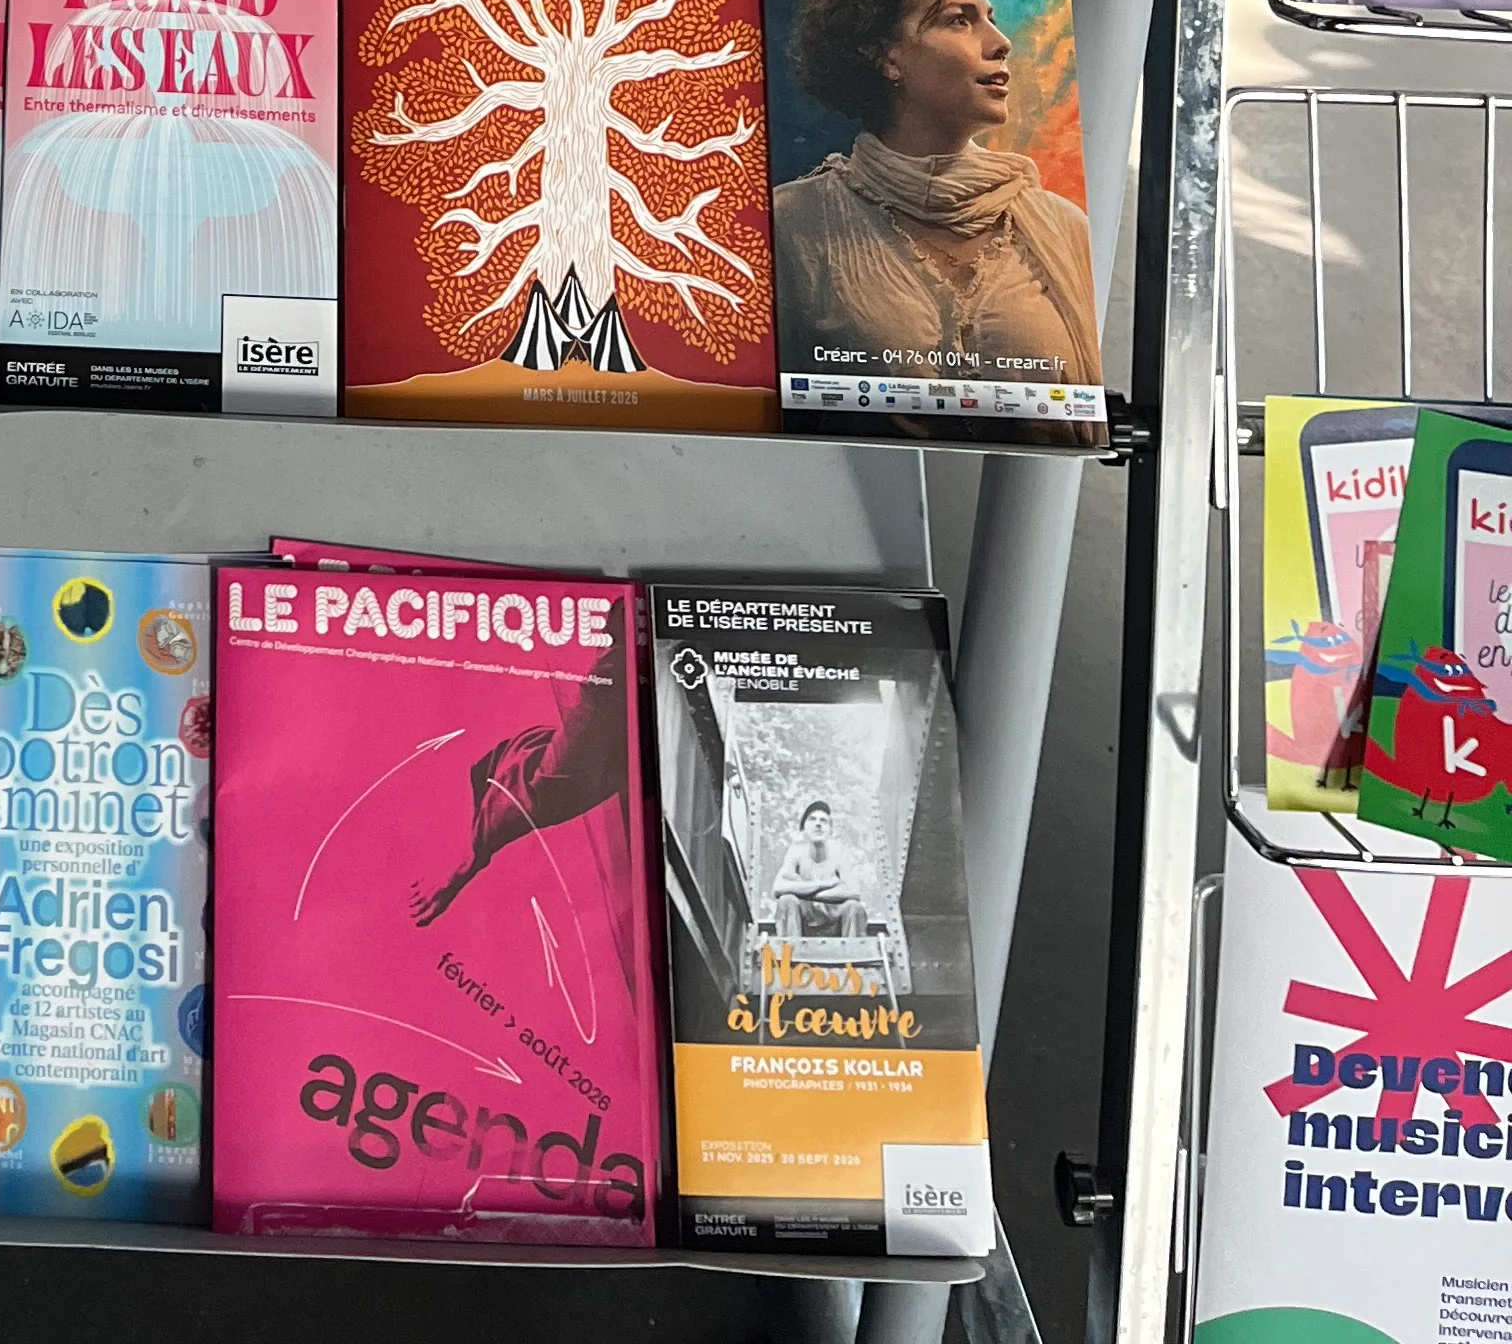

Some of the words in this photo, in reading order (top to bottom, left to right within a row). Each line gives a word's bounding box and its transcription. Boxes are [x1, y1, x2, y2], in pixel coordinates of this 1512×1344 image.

[24, 97, 65, 113] Entre
[69, 99, 167, 117] thermalisme
[192, 104, 316, 123] divertissements
[241, 336, 314, 365] isère
[814, 346, 867, 364] Créarc
[997, 355, 1067, 373] crearc.fr
[523, 388, 554, 402] MARS
[567, 390, 606, 404] JUILLET
[610, 390, 638, 405] 2026
[229, 582, 298, 633] LE
[315, 586, 613, 651] PACIFIQUE
[714, 651, 771, 664] MUSÉE
[775, 653, 798, 665] DE
[714, 665, 789, 678] L'ANCIEN
[794, 665, 860, 680] ÉVÊCHÉ
[27, 670, 144, 736] Dès
[55, 839, 144, 857] exposition
[437, 952, 505, 1017] février
[519, 1027, 569, 1077] août
[567, 1070, 612, 1112] 2026
[15, 1062, 138, 1084] contemporain
[730, 1056, 838, 1080] FRANÇOIS
[844, 1060, 923, 1077] KOLLAR
[299, 1053, 646, 1225] agenda
